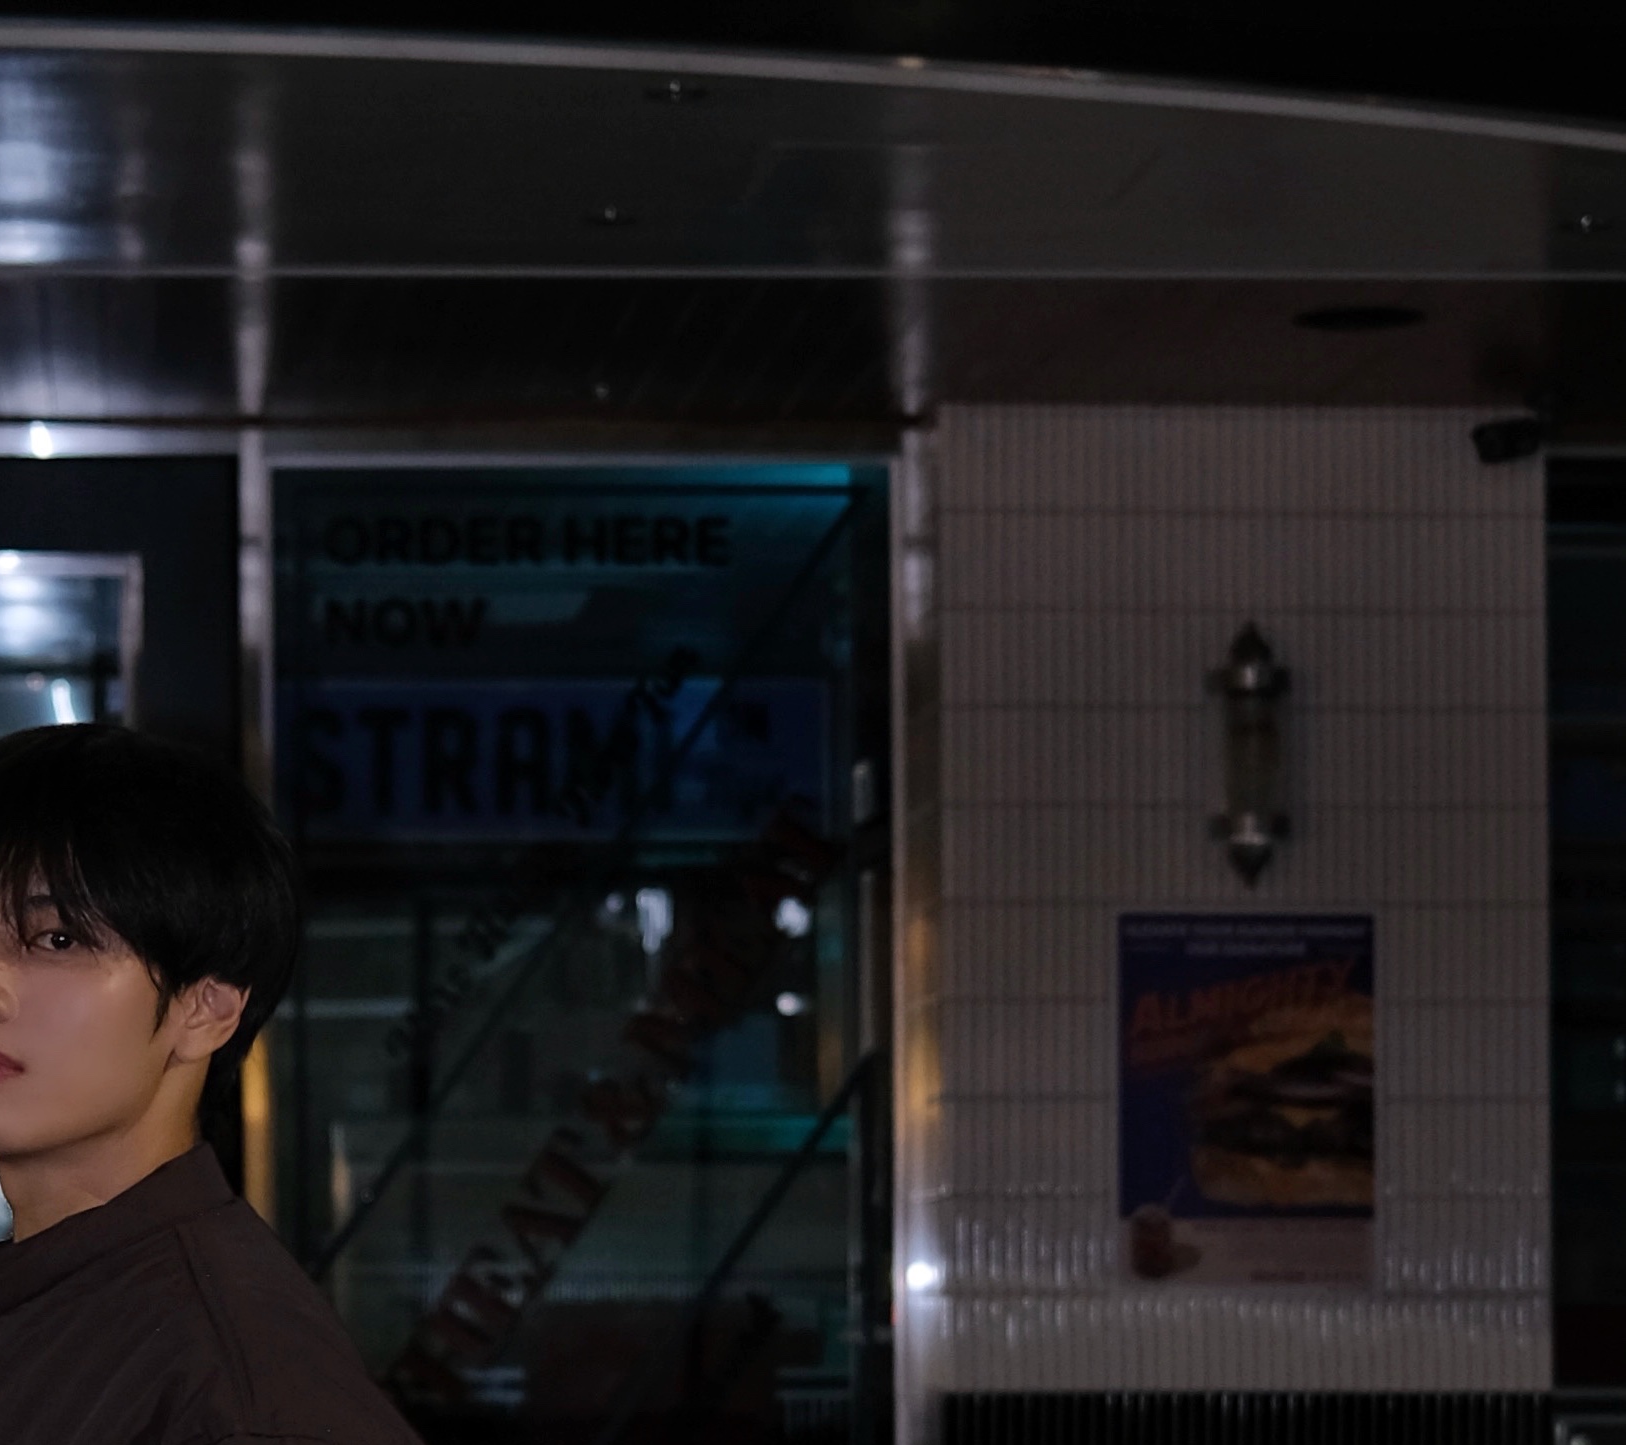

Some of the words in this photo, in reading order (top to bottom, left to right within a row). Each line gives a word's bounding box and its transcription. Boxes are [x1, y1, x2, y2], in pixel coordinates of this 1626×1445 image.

[324, 516, 542, 566] ORDER
[562, 516, 731, 567] HERE
[326, 600, 488, 647] NOW
